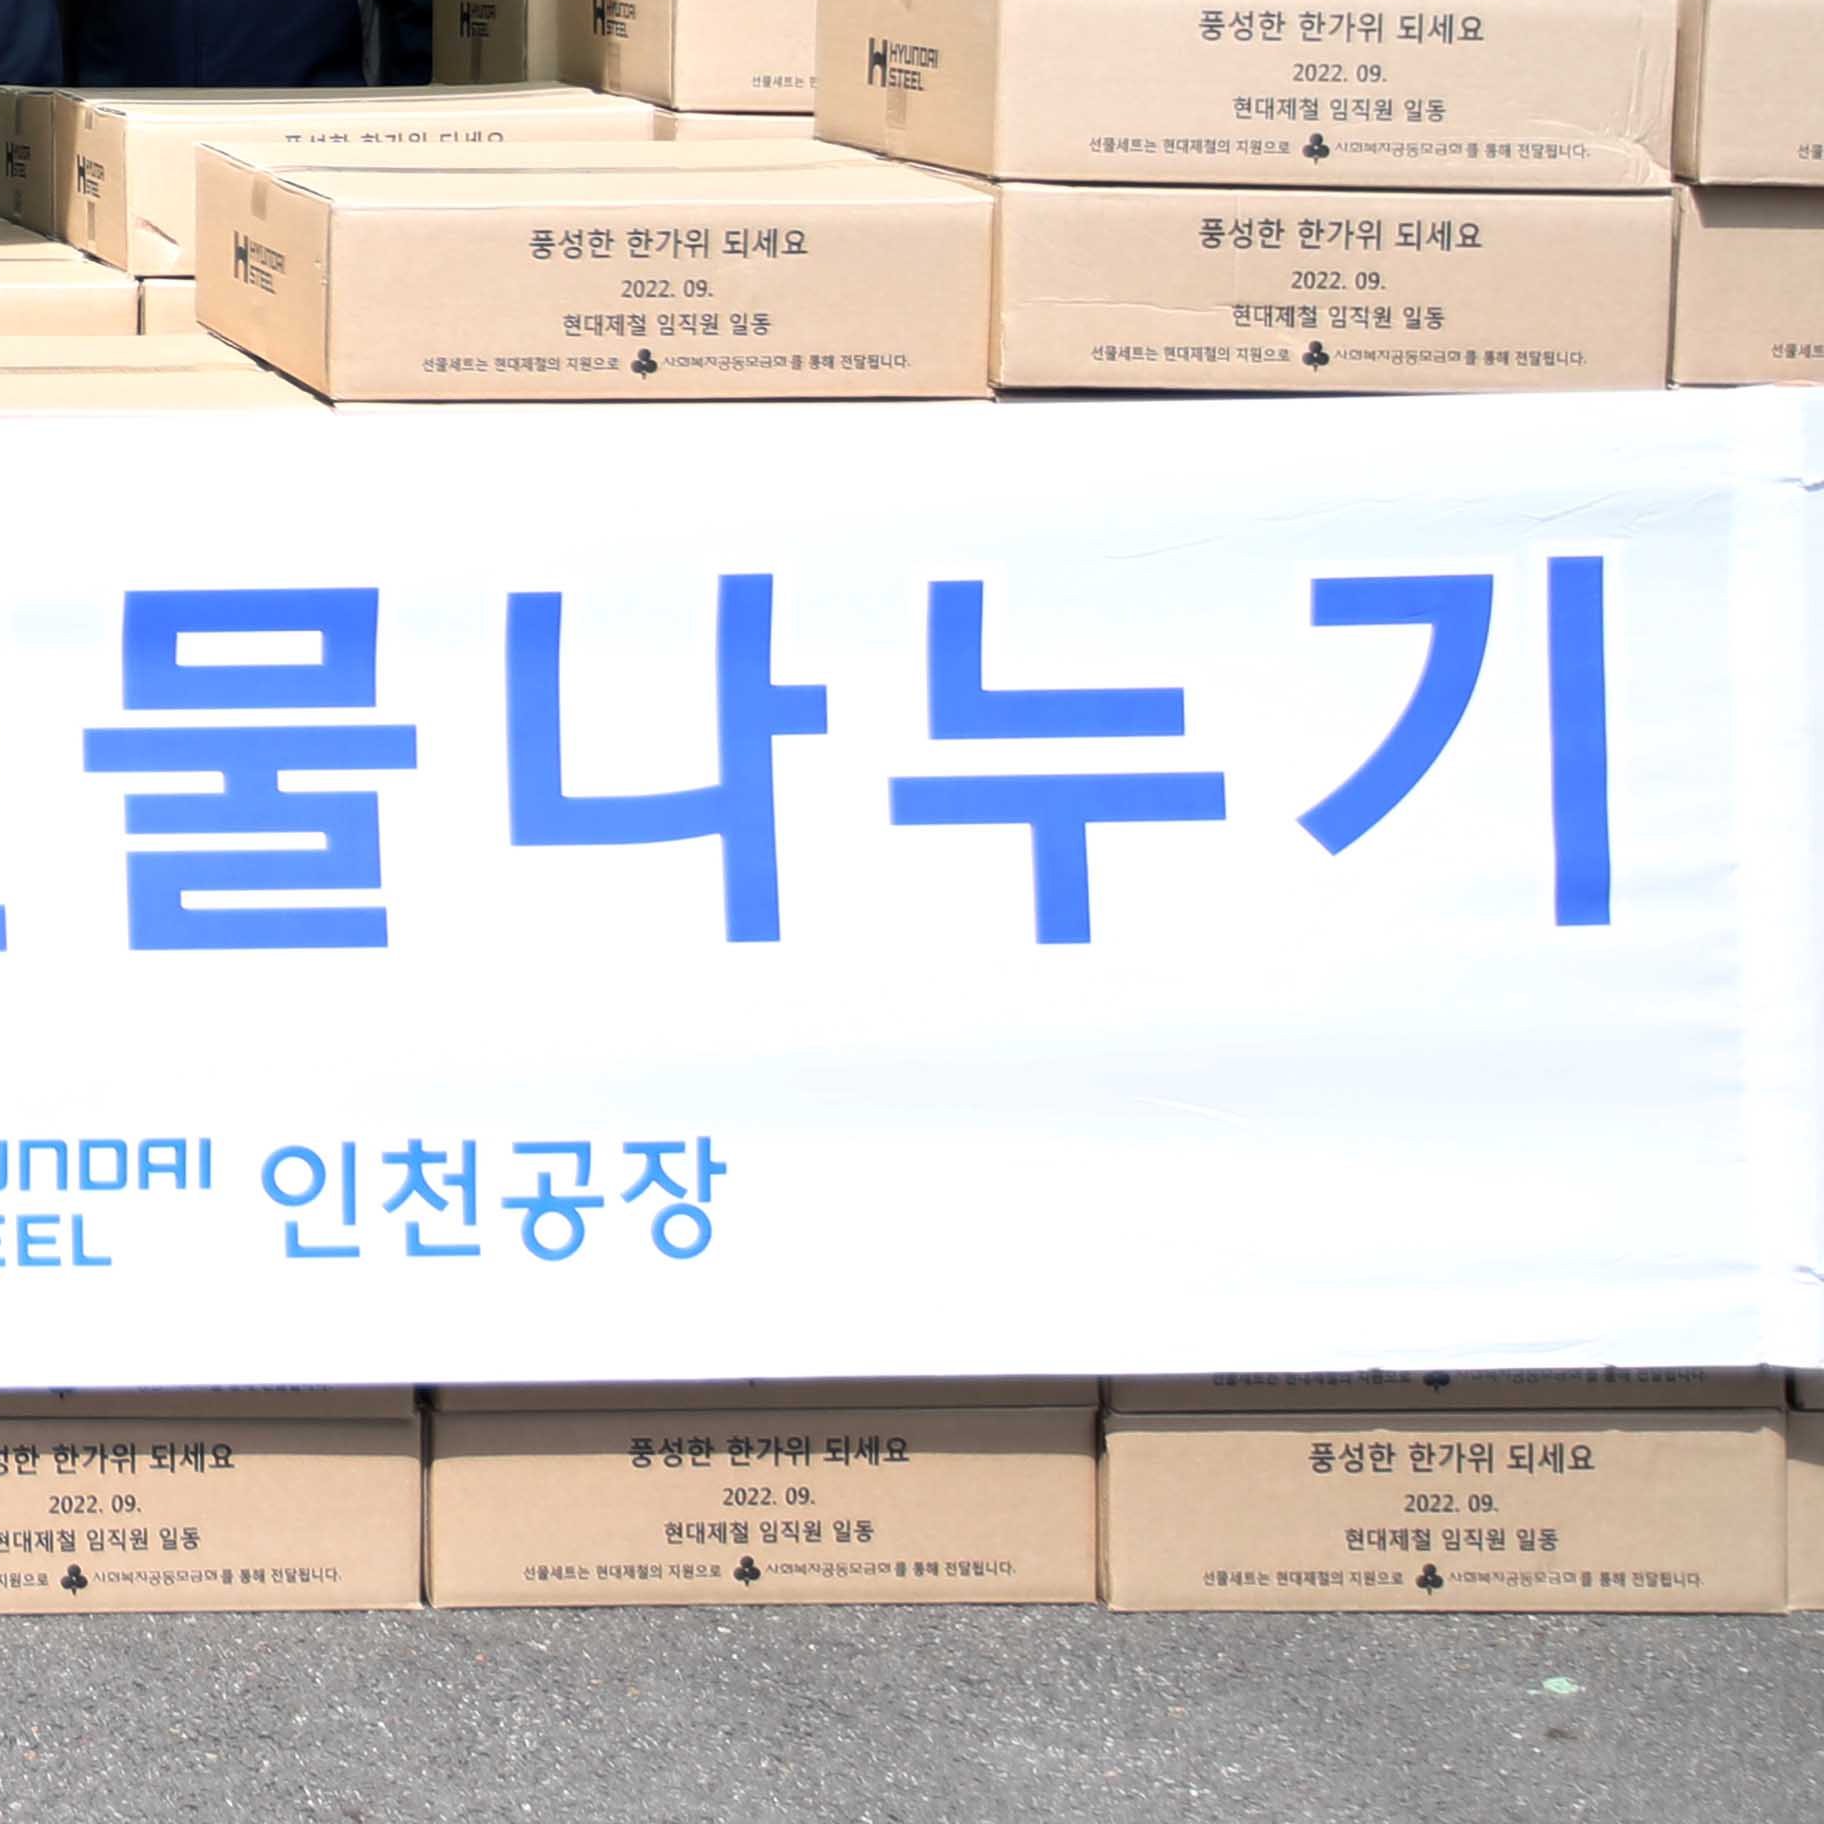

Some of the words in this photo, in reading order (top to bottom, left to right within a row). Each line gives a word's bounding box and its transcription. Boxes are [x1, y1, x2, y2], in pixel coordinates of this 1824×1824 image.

[1198, 10, 1288, 43] 풍성한
[1298, 10, 1384, 45] 한가위
[1396, 12, 1486, 46] 되세요
[888, 42, 940, 69] HYUNDAI
[888, 67, 925, 92] STEEL
[1292, 63, 1350, 84] 2022.
[1355, 63, 1389, 84] 09.
[1231, 95, 1320, 123] 현대제철
[1329, 98, 1394, 123] 임직원
[1403, 98, 1447, 124] 일동
[529, 228, 616, 261] 풍성한
[626, 228, 711, 260] 한가위
[722, 228, 810, 260] 되세요
[1198, 217, 1287, 251] 풍성한
[1297, 218, 1383, 252] 한가위
[1395, 219, 1483, 253] 되세요
[258, 1135, 731, 1264] 인천공장
[51, 1442, 137, 1475] 한가위
[148, 1441, 235, 1473] 되세요
[628, 1435, 712, 1469] 풍성한
[726, 1434, 812, 1468] 한가위
[822, 1434, 911, 1465] 되세요
[1308, 1441, 1398, 1475] 풍성한
[1408, 1441, 1495, 1475] 한가위
[1507, 1442, 1597, 1476] 되세요
